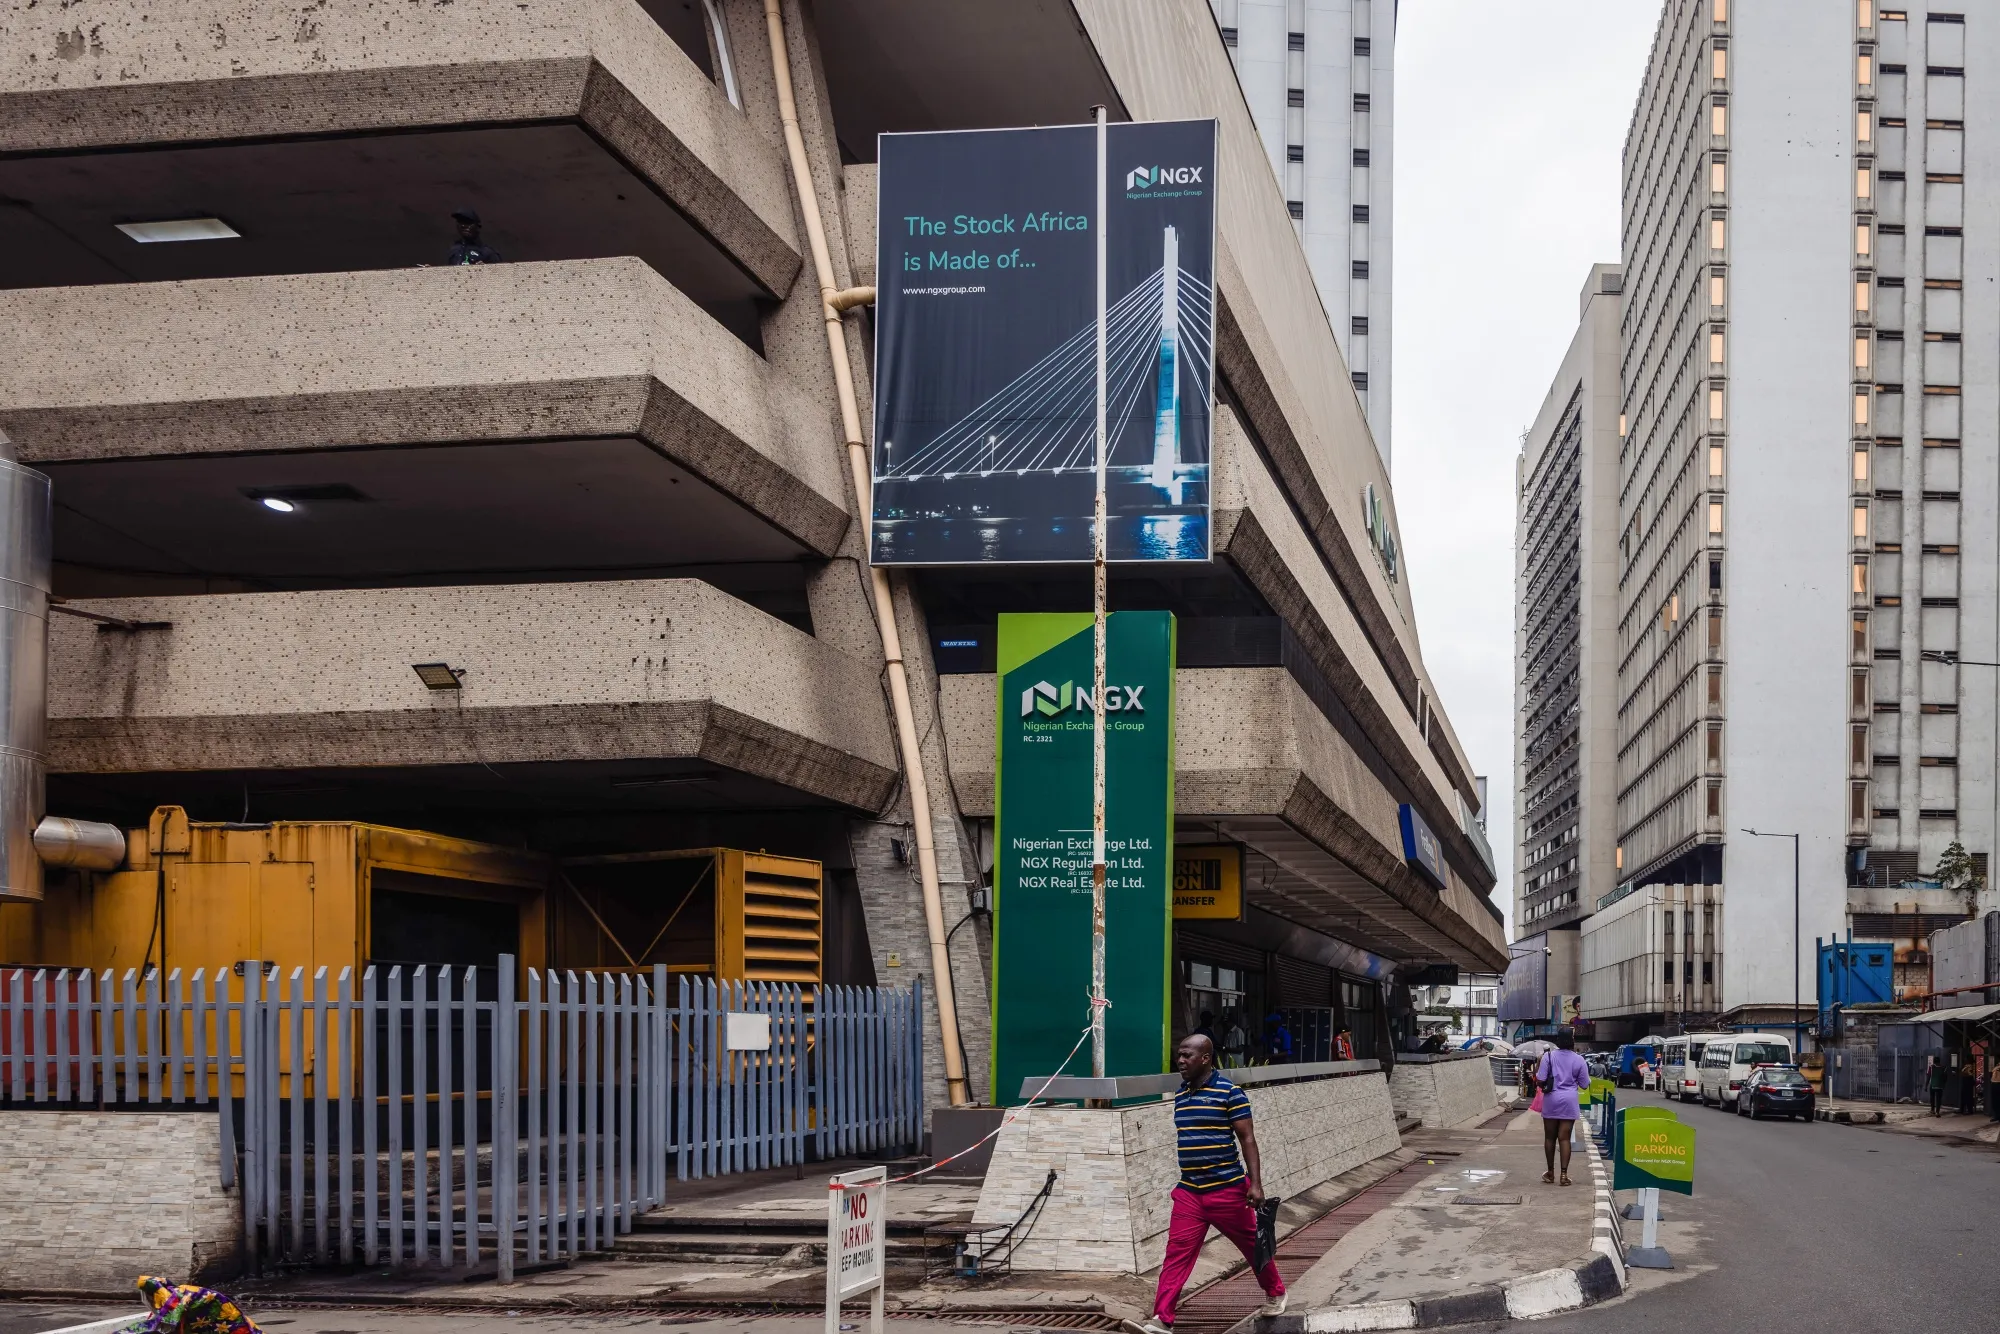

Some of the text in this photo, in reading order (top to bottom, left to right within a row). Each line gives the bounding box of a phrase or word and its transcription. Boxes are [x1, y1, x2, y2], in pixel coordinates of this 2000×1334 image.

[1160, 166, 1203, 185] NGX
[1126, 189, 1203, 200] Nigerian Exchange Group
[903, 211, 1088, 236] The Stock Africa
[904, 248, 1036, 271] is Made of...
[902, 285, 986, 296] www.ngxgroup.com
[1076, 685, 1145, 712] NGX
[1023, 721, 1145, 733] Nigerian Exchae Group
[1023, 735, 1053, 743] RC. 2321
[1013, 837, 1152, 852] Nigerian Exchnge Ltd.
[1021, 857, 1145, 871] NGX Regulaon Ltd.
[1019, 876, 1145, 888] NGX Real Este Ltd.
[1173, 896, 1215, 906] ANSFER
[1650, 1133, 1668, 1143] NO
[1634, 1144, 1686, 1156] PARKING
[850, 1192, 867, 1220] NO
[841, 1254, 852, 1272] EEP
